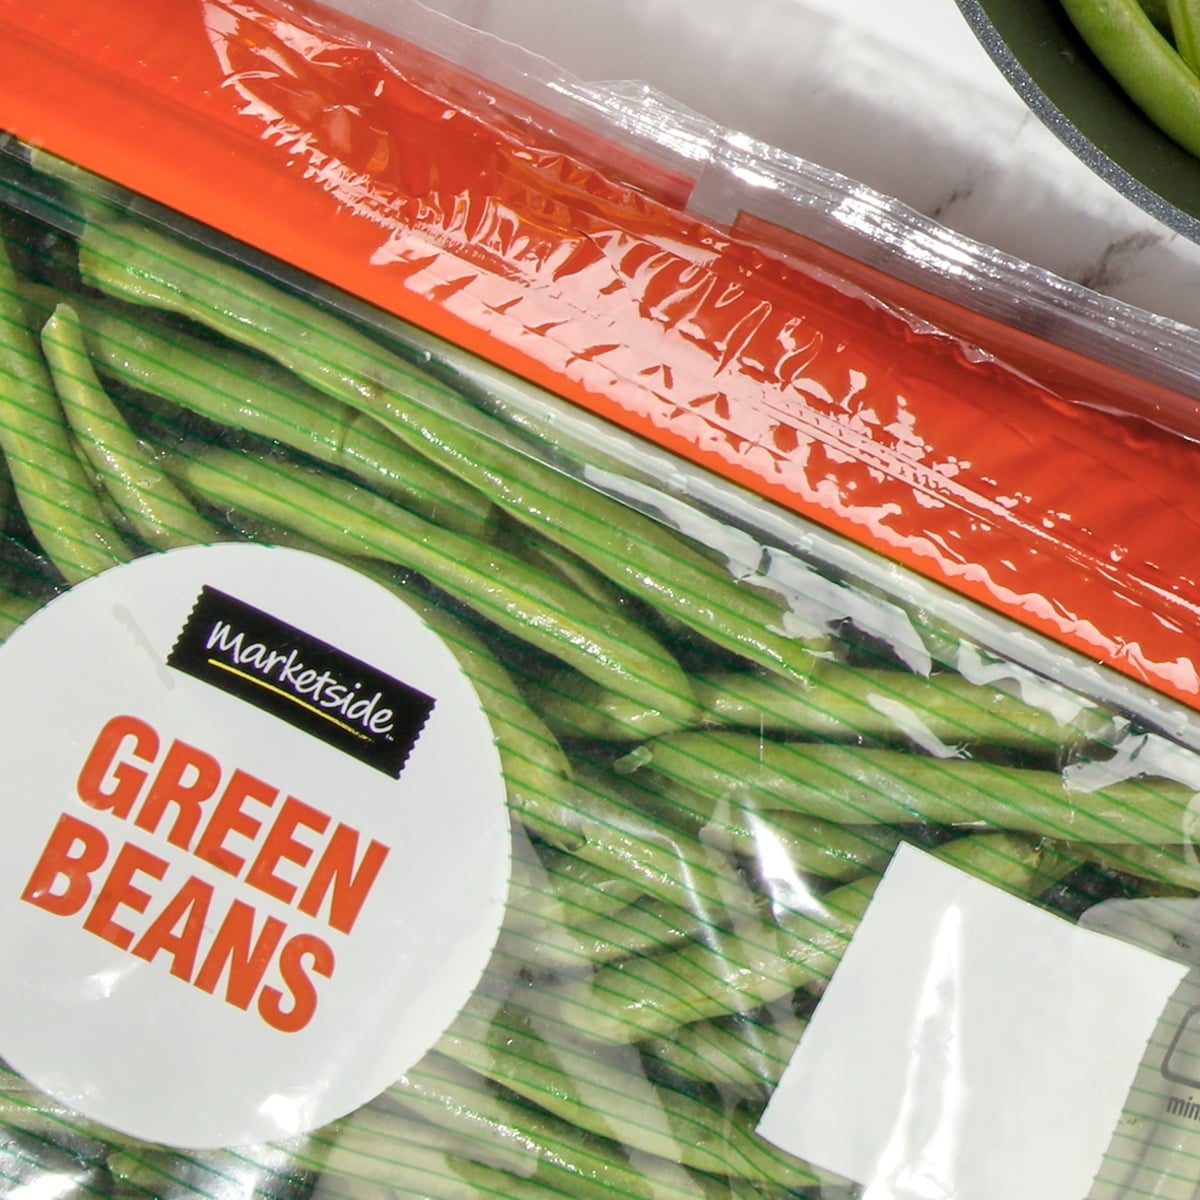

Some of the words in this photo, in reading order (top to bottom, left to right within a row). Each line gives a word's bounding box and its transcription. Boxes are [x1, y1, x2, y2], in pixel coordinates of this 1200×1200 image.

[206, 620, 394, 734] Marketside
[20, 812, 335, 1033] BEANS
[76, 714, 391, 936] GREEN
